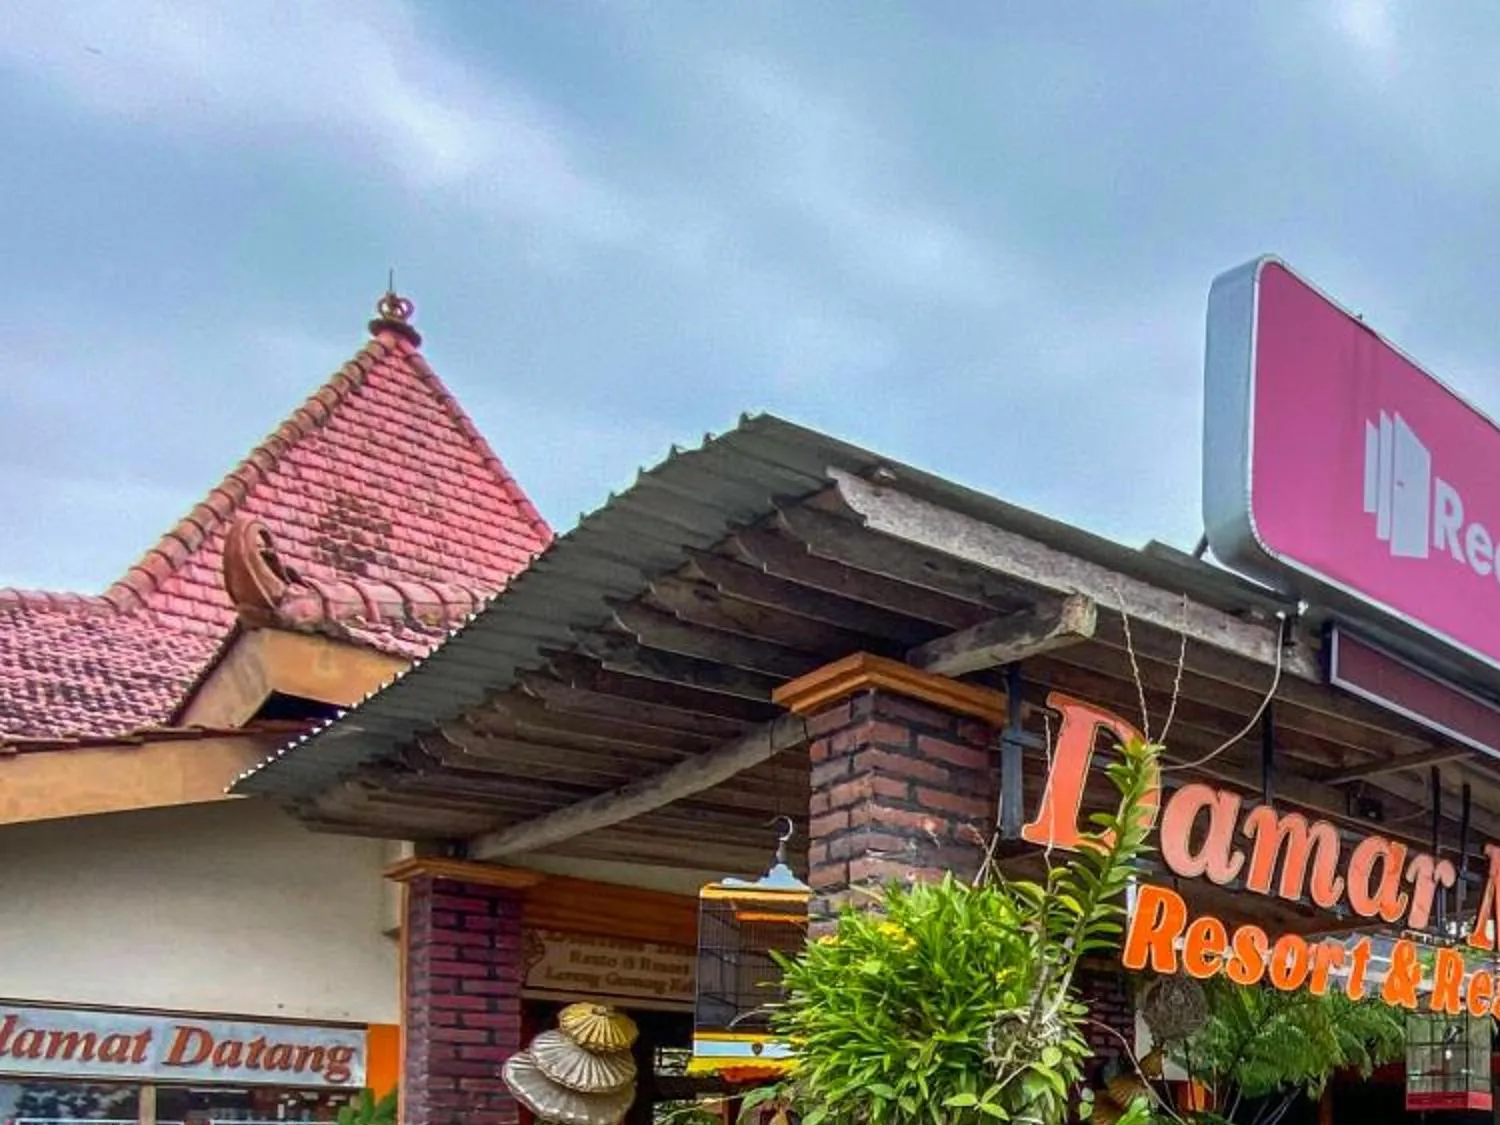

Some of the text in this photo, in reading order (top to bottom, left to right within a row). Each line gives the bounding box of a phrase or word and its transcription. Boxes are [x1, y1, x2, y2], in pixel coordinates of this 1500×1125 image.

[1022, 691, 1457, 930] Damar
[1122, 884, 1372, 1001] Resort
[1381, 938, 1431, 1009] &
[161, 1025, 356, 1083] Datang
